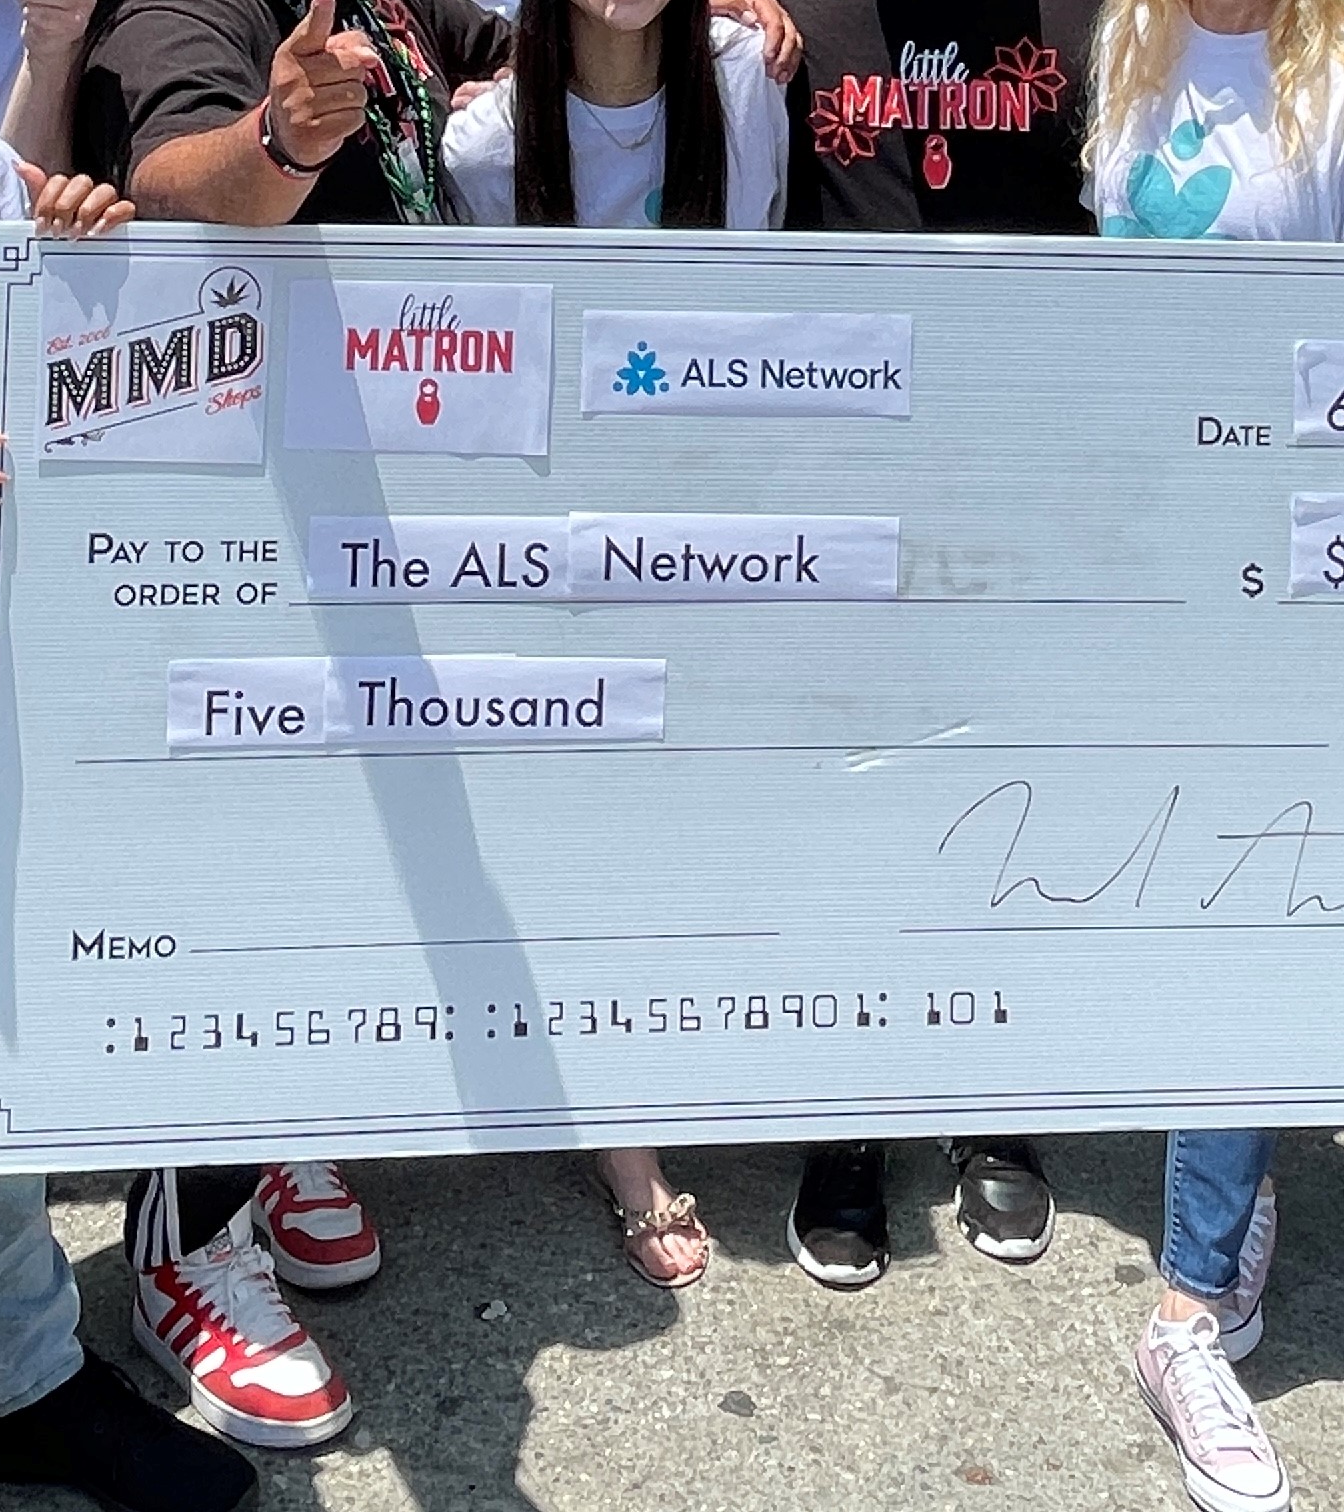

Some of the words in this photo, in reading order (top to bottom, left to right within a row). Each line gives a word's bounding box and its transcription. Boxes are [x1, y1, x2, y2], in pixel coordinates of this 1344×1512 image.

[899, 40, 970, 85] little
[842, 74, 1031, 133] MATRON
[400, 293, 461, 333] little
[345, 327, 514, 374] MATRON
[45, 312, 264, 430] MMD
[680, 358, 748, 389] ALS
[760, 360, 902, 390] Network
[205, 384, 262, 416] Shops
[219, 538, 279, 563] THE
[341, 538, 430, 589] The
[450, 542, 550, 589] ALS
[603, 535, 820, 584] Network
[113, 583, 221, 607] ORDER
[236, 582, 279, 606] OF
[1241, 563, 1264, 598] $
[204, 690, 306, 737] Five
[359, 678, 605, 729] Thousand
[926, 990, 1008, 1026] 101
